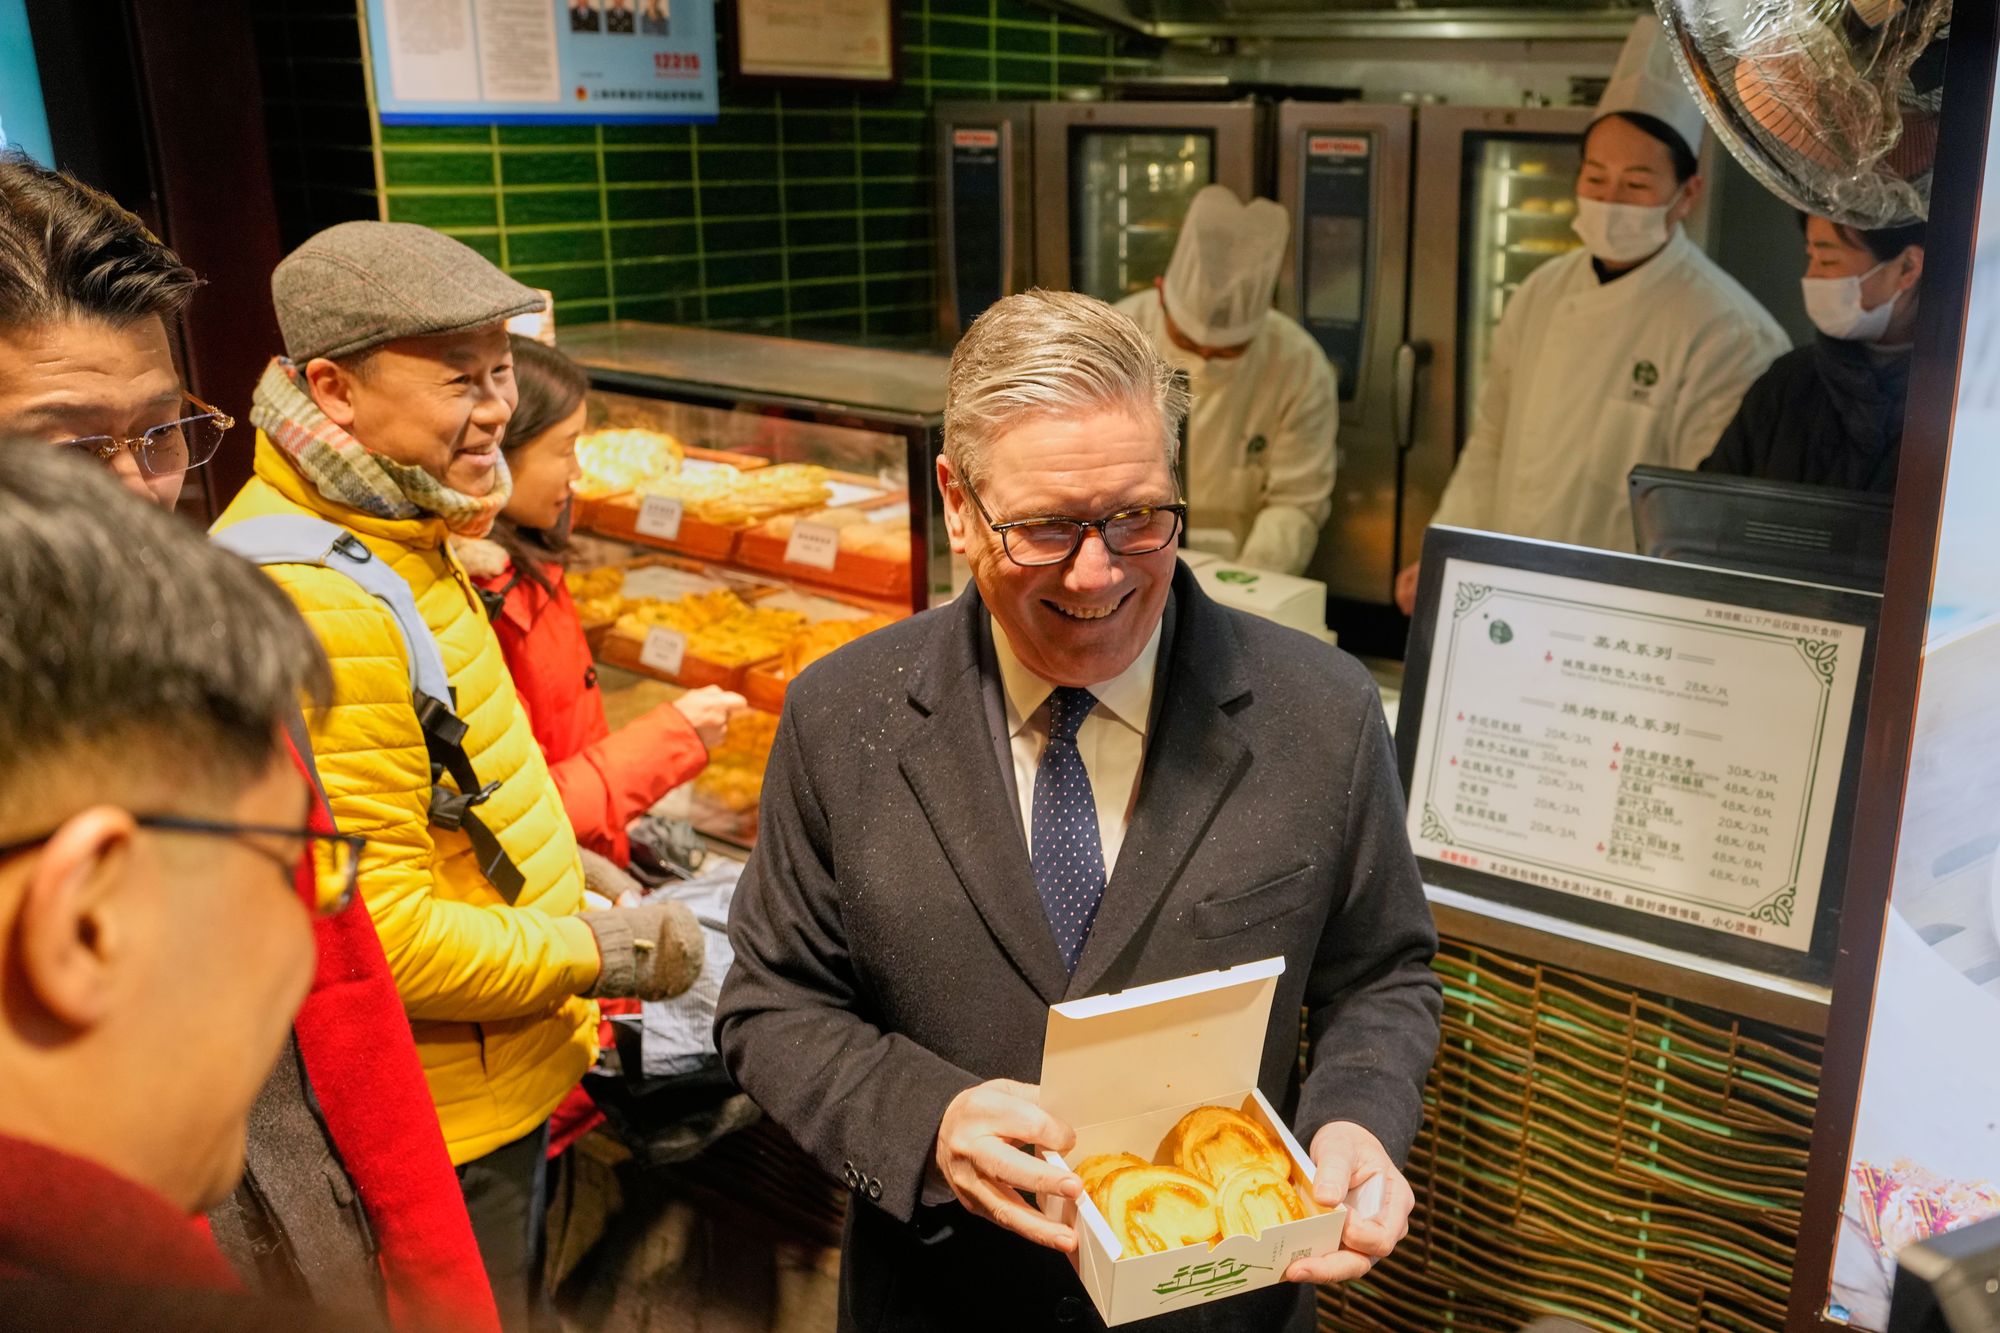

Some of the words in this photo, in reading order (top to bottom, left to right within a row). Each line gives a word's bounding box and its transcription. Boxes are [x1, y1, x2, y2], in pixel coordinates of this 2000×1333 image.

[654, 51, 700, 70] 12315
[1591, 633, 1673, 661] 蒸点系列
[1559, 699, 1681, 737] 烘烤酥点系列
